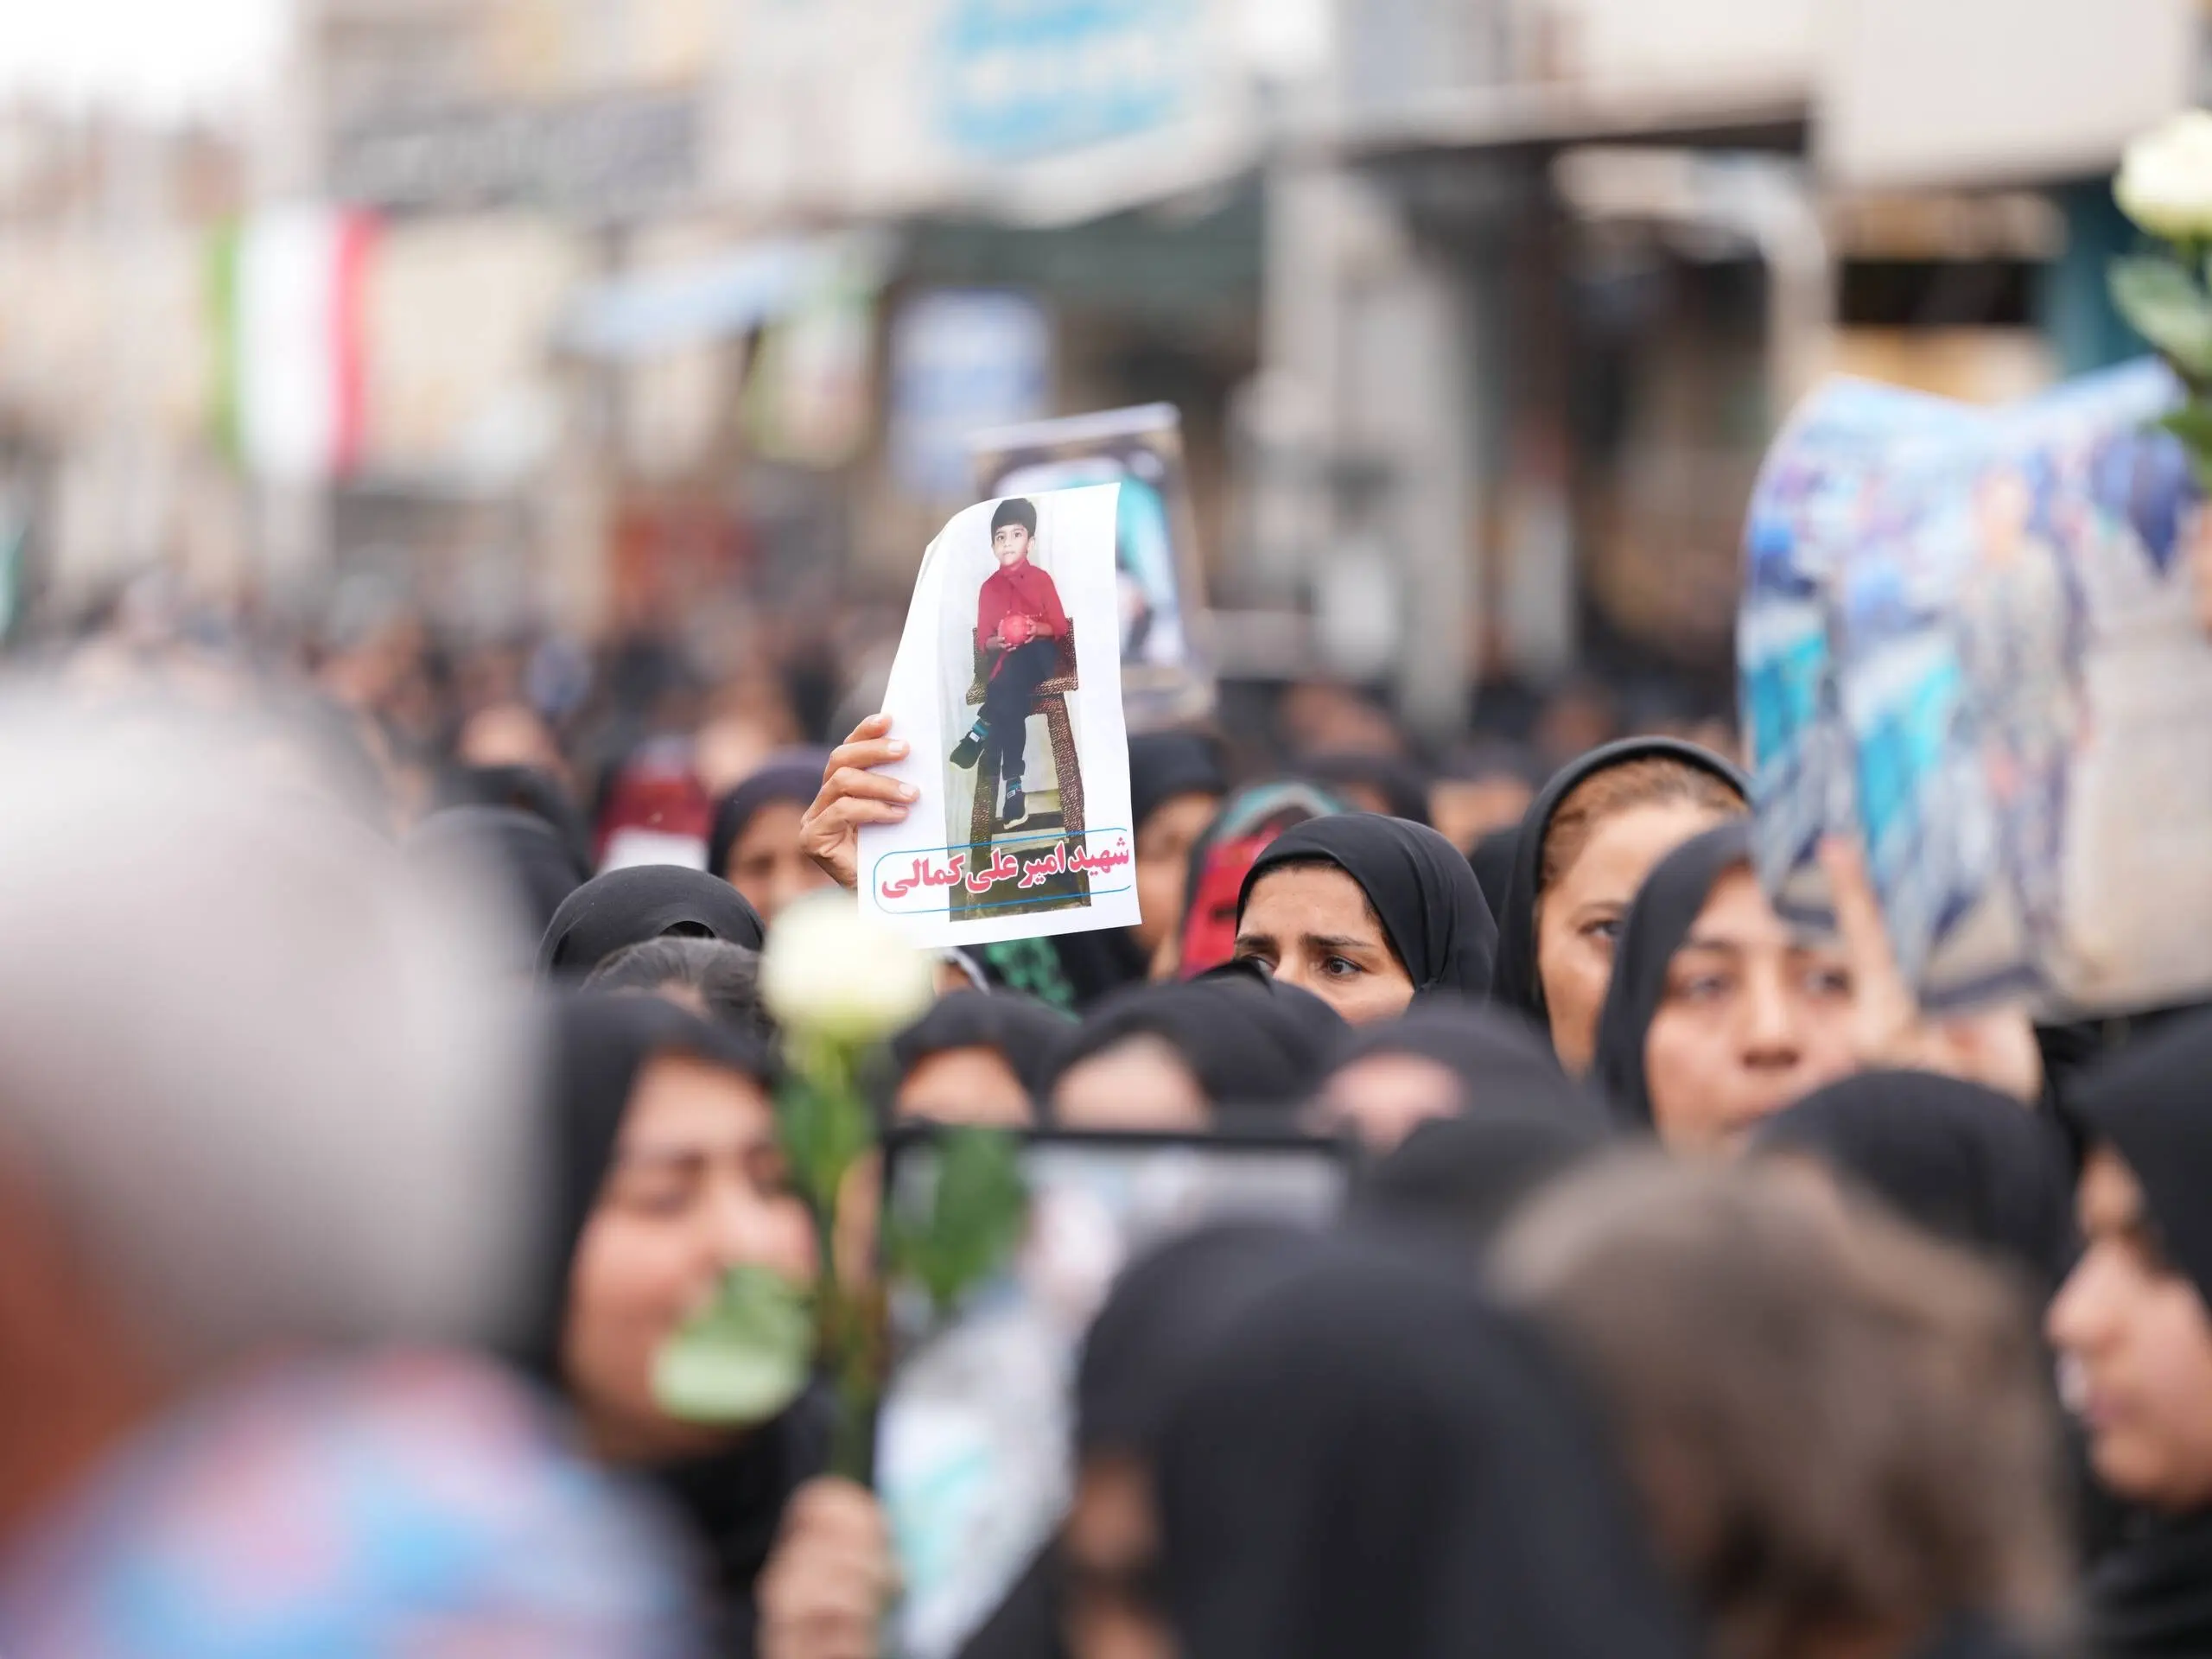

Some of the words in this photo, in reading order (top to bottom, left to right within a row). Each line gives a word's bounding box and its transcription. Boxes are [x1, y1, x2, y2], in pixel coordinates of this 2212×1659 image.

[881, 854, 965, 899] کمالی
[965, 849, 1018, 892] علی
[1018, 841, 1065, 887] امیر
[1068, 836, 1130, 877] شهید
